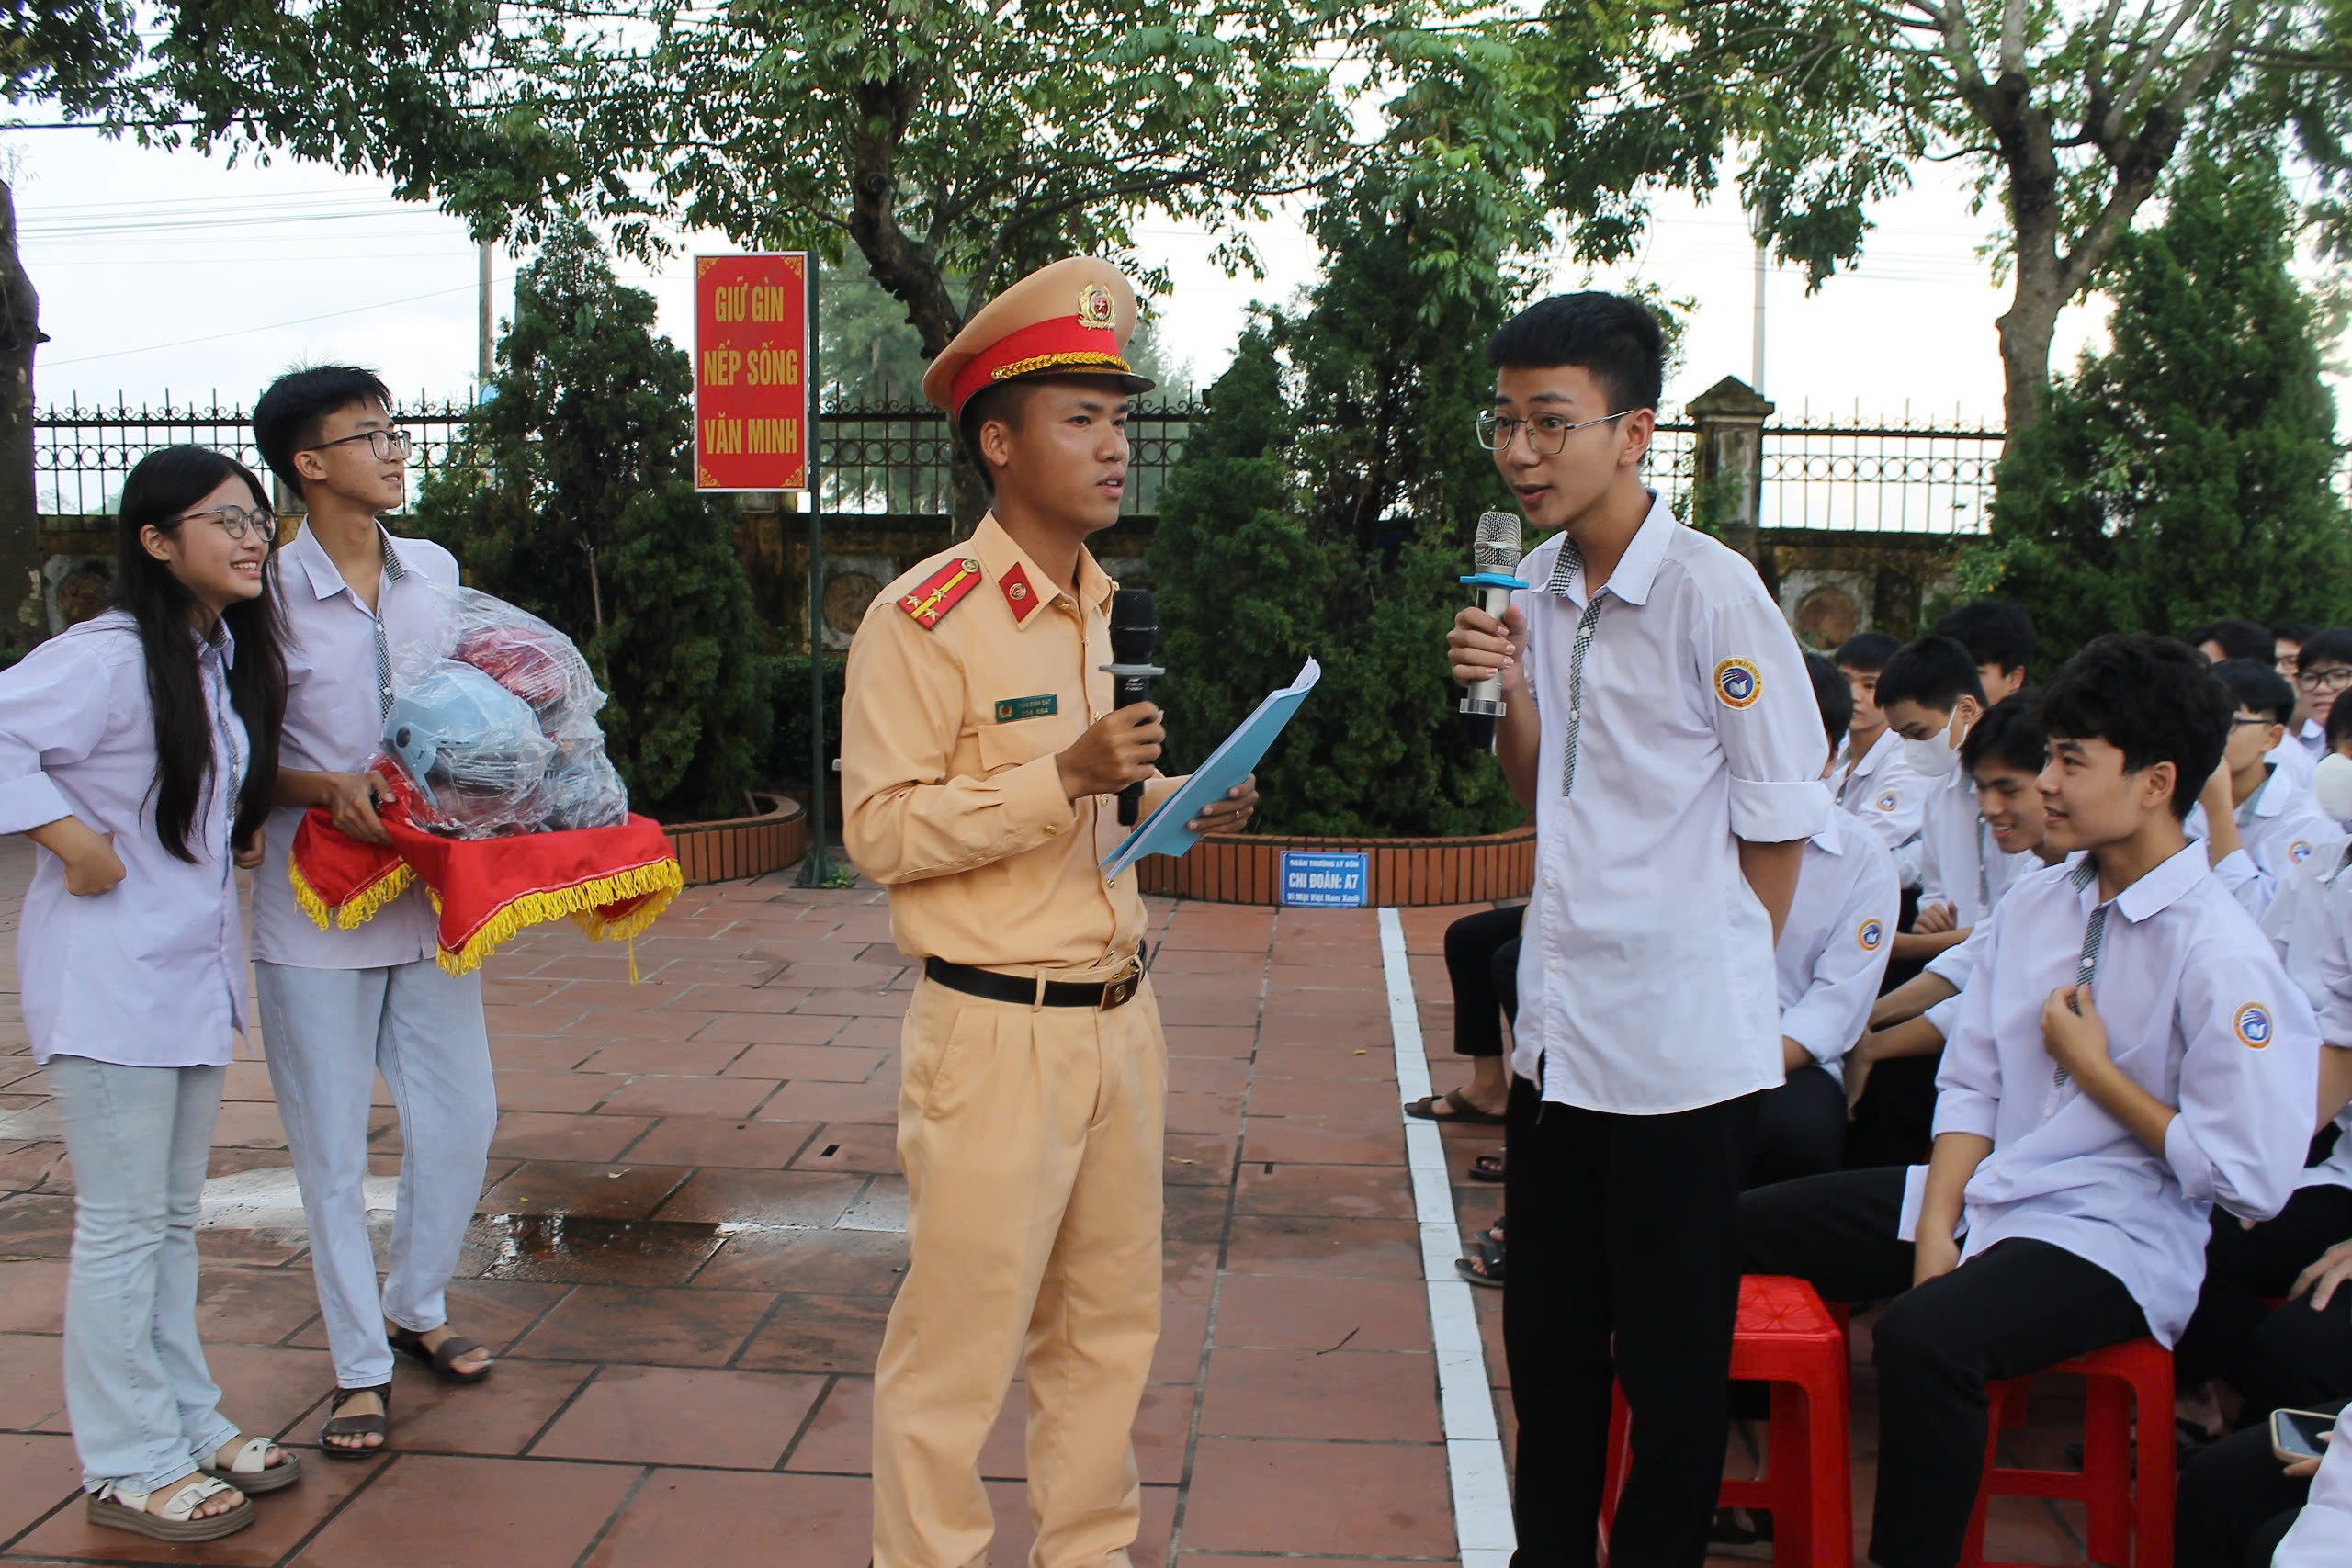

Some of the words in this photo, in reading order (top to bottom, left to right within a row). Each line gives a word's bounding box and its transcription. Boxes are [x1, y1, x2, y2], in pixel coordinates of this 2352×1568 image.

[715, 276, 749, 322] GIỮ
[752, 276, 784, 322] GÌN
[704, 339, 741, 386] NẾP
[747, 340, 798, 386] SỐNG
[704, 412, 742, 455] VĂN
[747, 418, 798, 455] MINH
[1289, 872, 1307, 889] CHI
[1309, 870, 1342, 889] ĐOÀN:
[1344, 873, 1360, 890] A7
